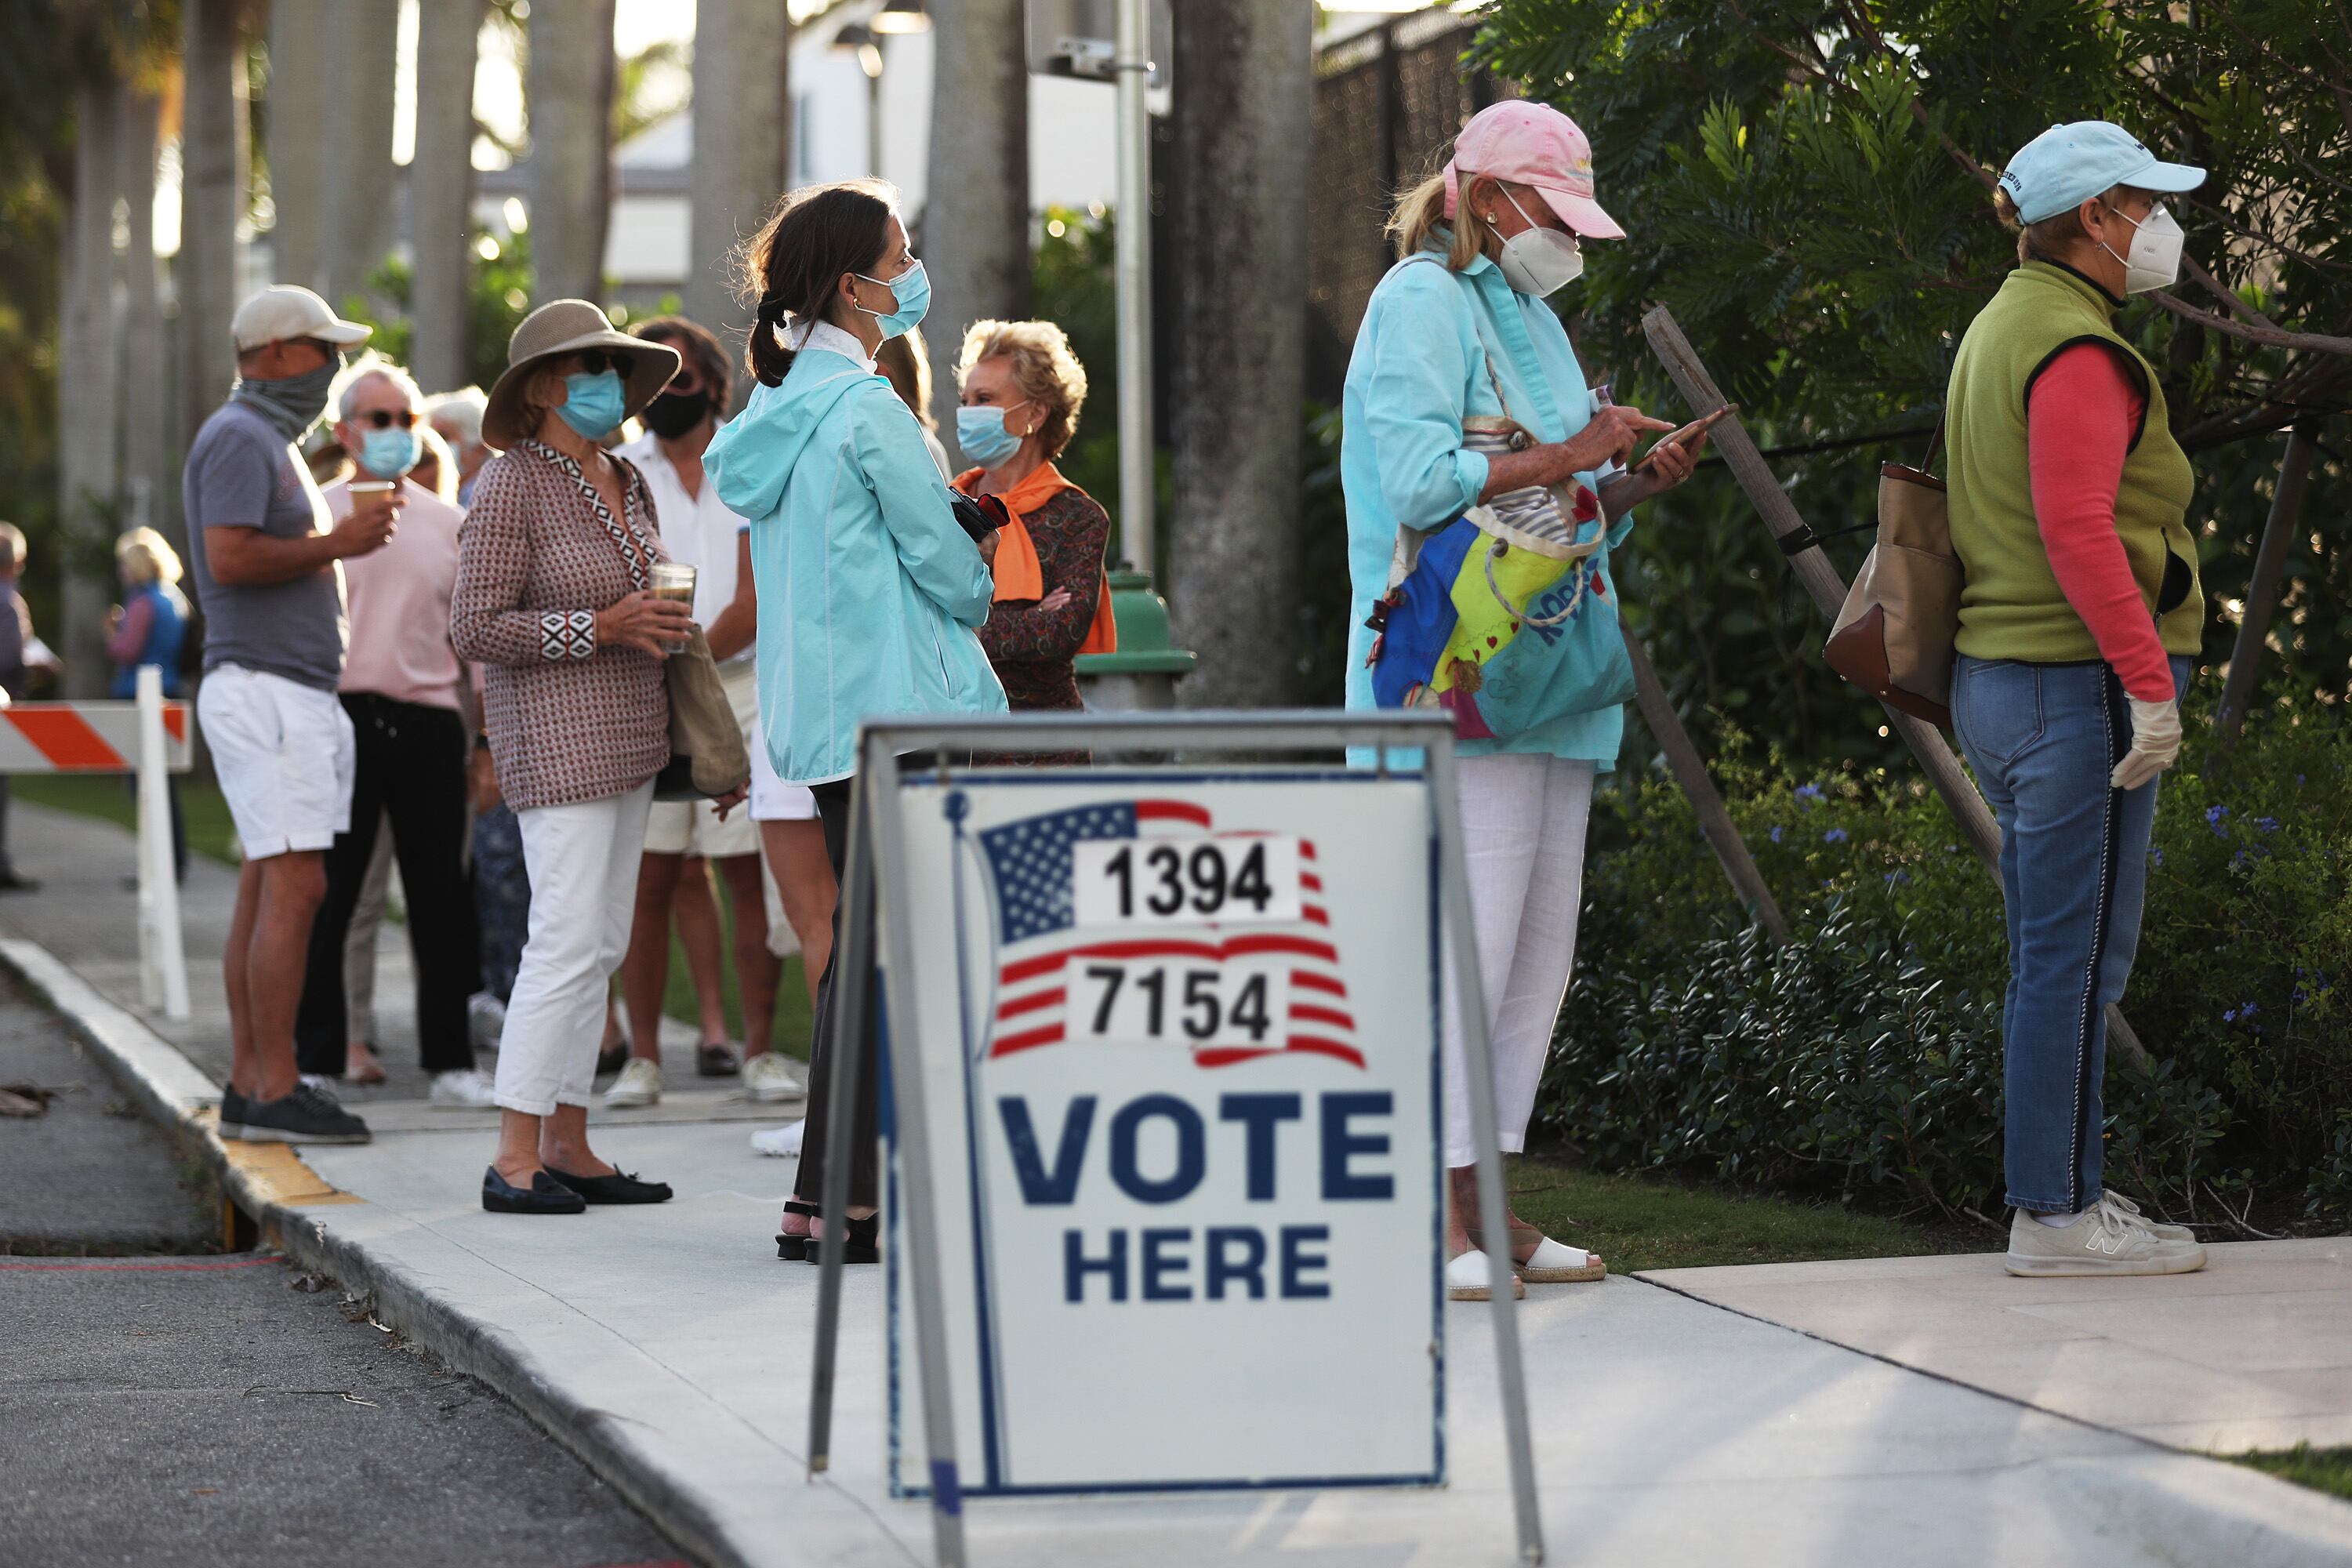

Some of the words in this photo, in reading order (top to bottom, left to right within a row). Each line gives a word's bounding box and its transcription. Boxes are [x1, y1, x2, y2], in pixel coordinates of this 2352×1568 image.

[1104, 843, 1272, 917] 1394
[1085, 965, 1271, 1040] 7154
[996, 1091, 1395, 1207] VOTE
[1063, 1225, 1331, 1304] HERE
